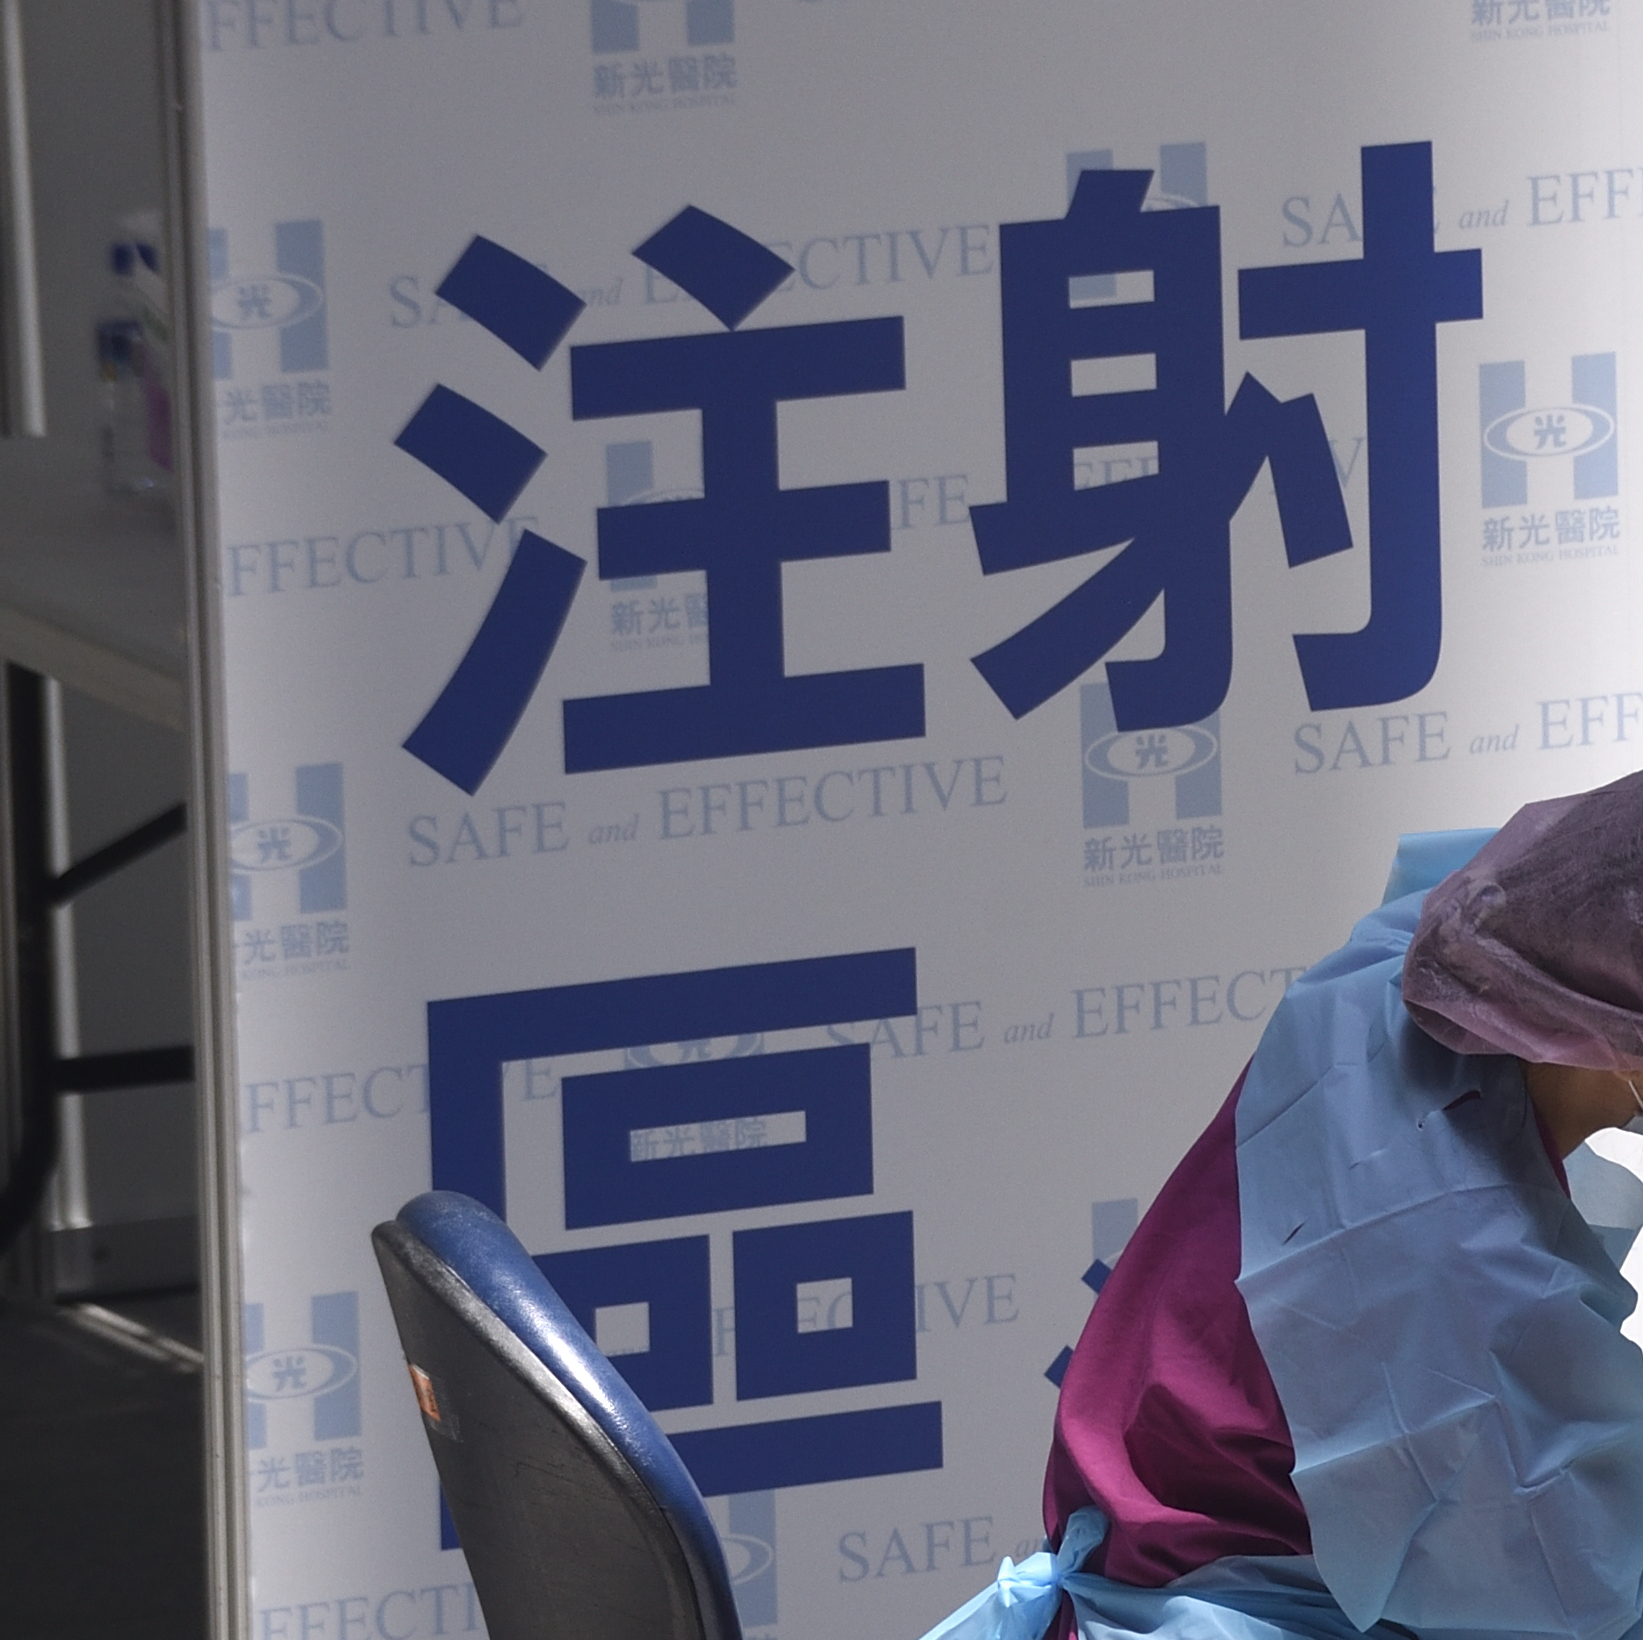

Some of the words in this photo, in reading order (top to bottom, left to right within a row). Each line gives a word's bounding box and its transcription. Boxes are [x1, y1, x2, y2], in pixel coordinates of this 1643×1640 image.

[1459, 200, 1510, 231] and
[643, 222, 997, 305] EECTIVE
[400, 140, 1483, 792] 注射
[1481, 506, 1620, 551] 新光醫院
[1293, 711, 1452, 777] SAFE
[1469, 723, 1519, 756] and
[407, 800, 570, 868] SAFE
[586, 812, 640, 846] and
[654, 754, 1007, 841] EFFECTIVE
[1083, 825, 1225, 873] 新光醫院
[1003, 1012, 1055, 1044] and
[426, 948, 941, 1550] 區
[837, 1515, 995, 1583] SAFE
